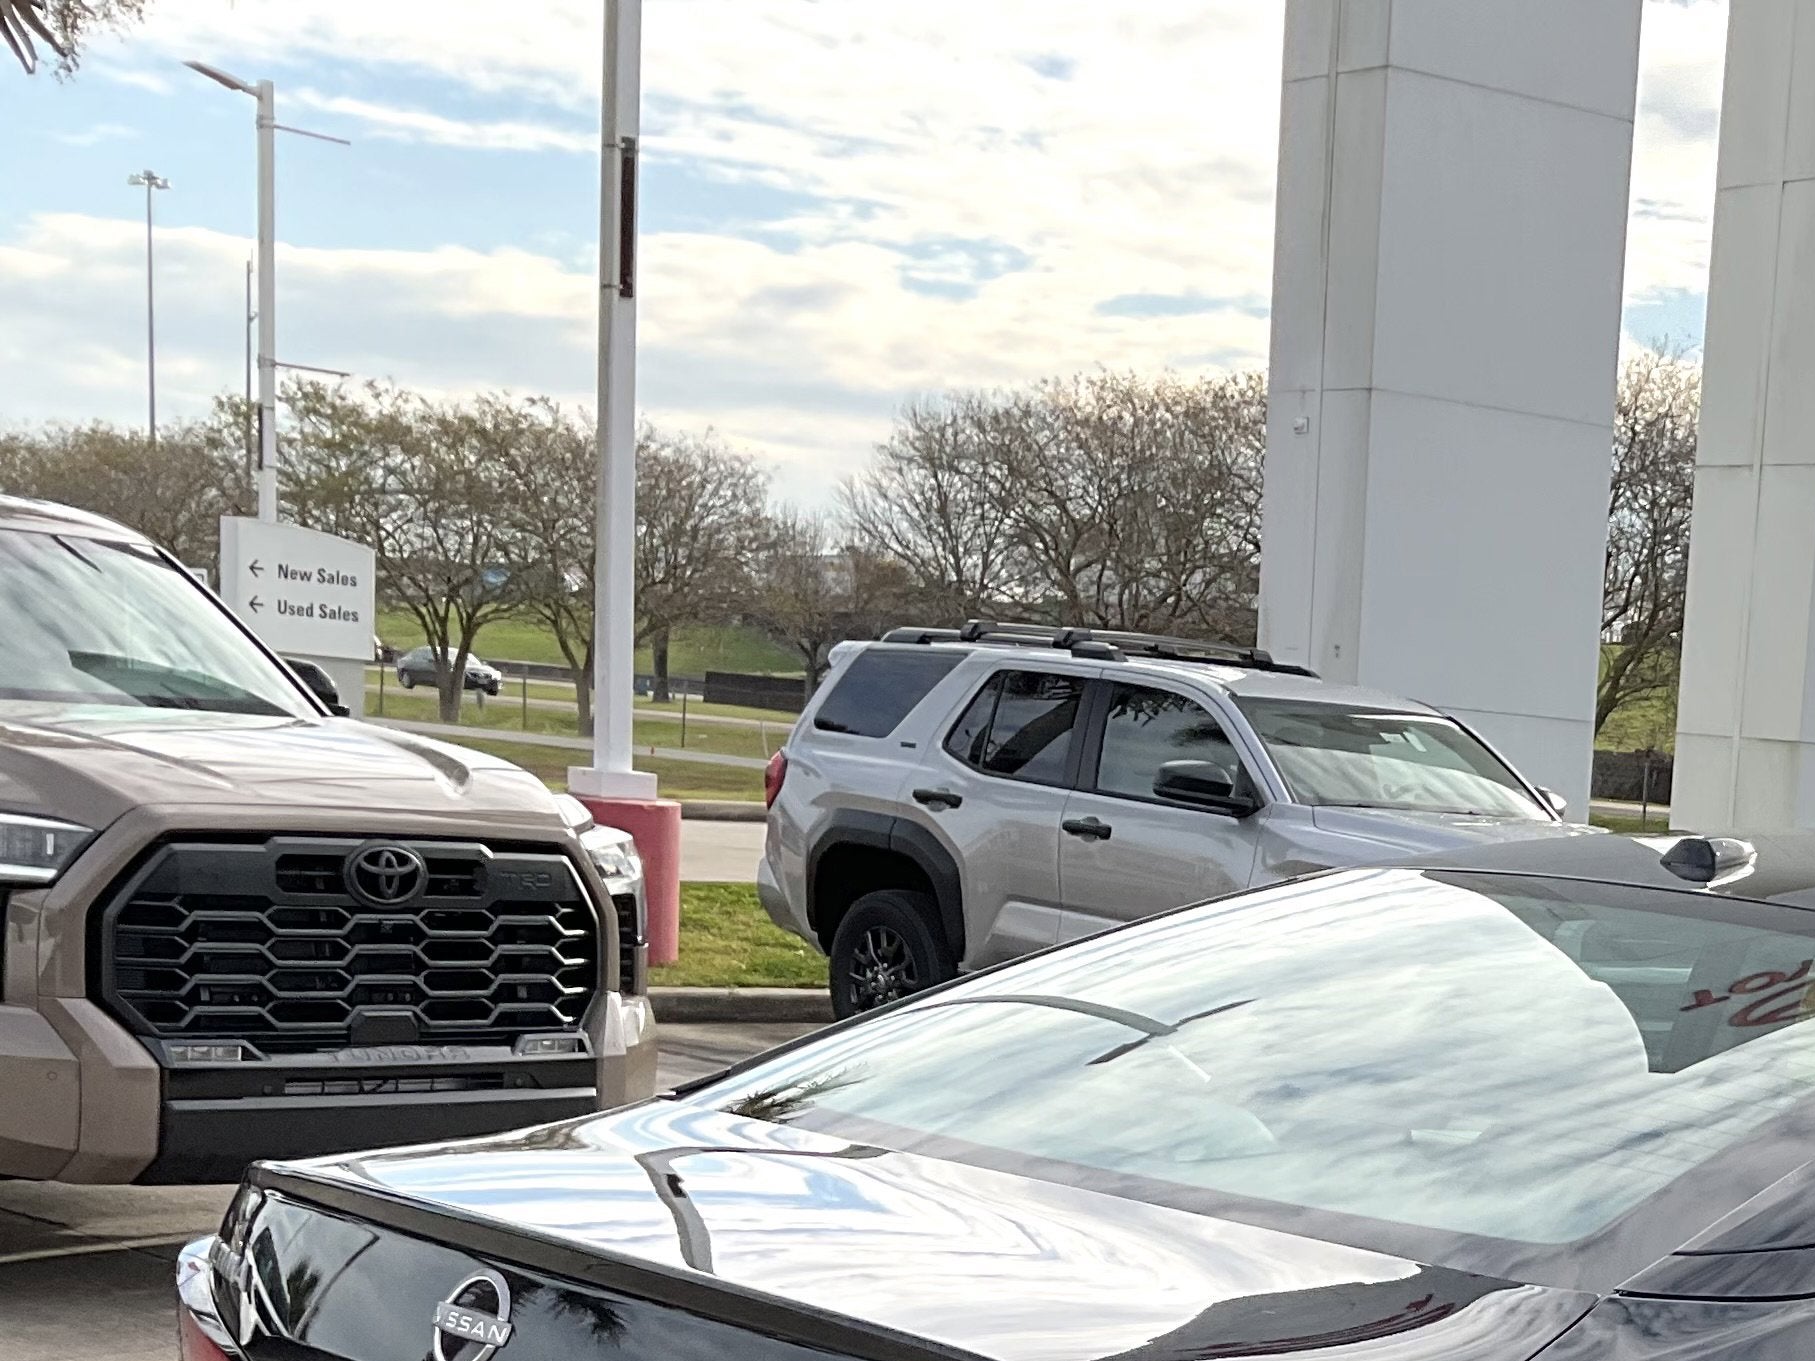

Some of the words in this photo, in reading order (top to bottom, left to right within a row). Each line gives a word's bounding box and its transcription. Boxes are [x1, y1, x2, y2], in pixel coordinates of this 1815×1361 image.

[277, 563, 312, 583] New
[317, 567, 358, 588] Sales
[277, 599, 314, 618] Used
[318, 603, 359, 623] Sales
